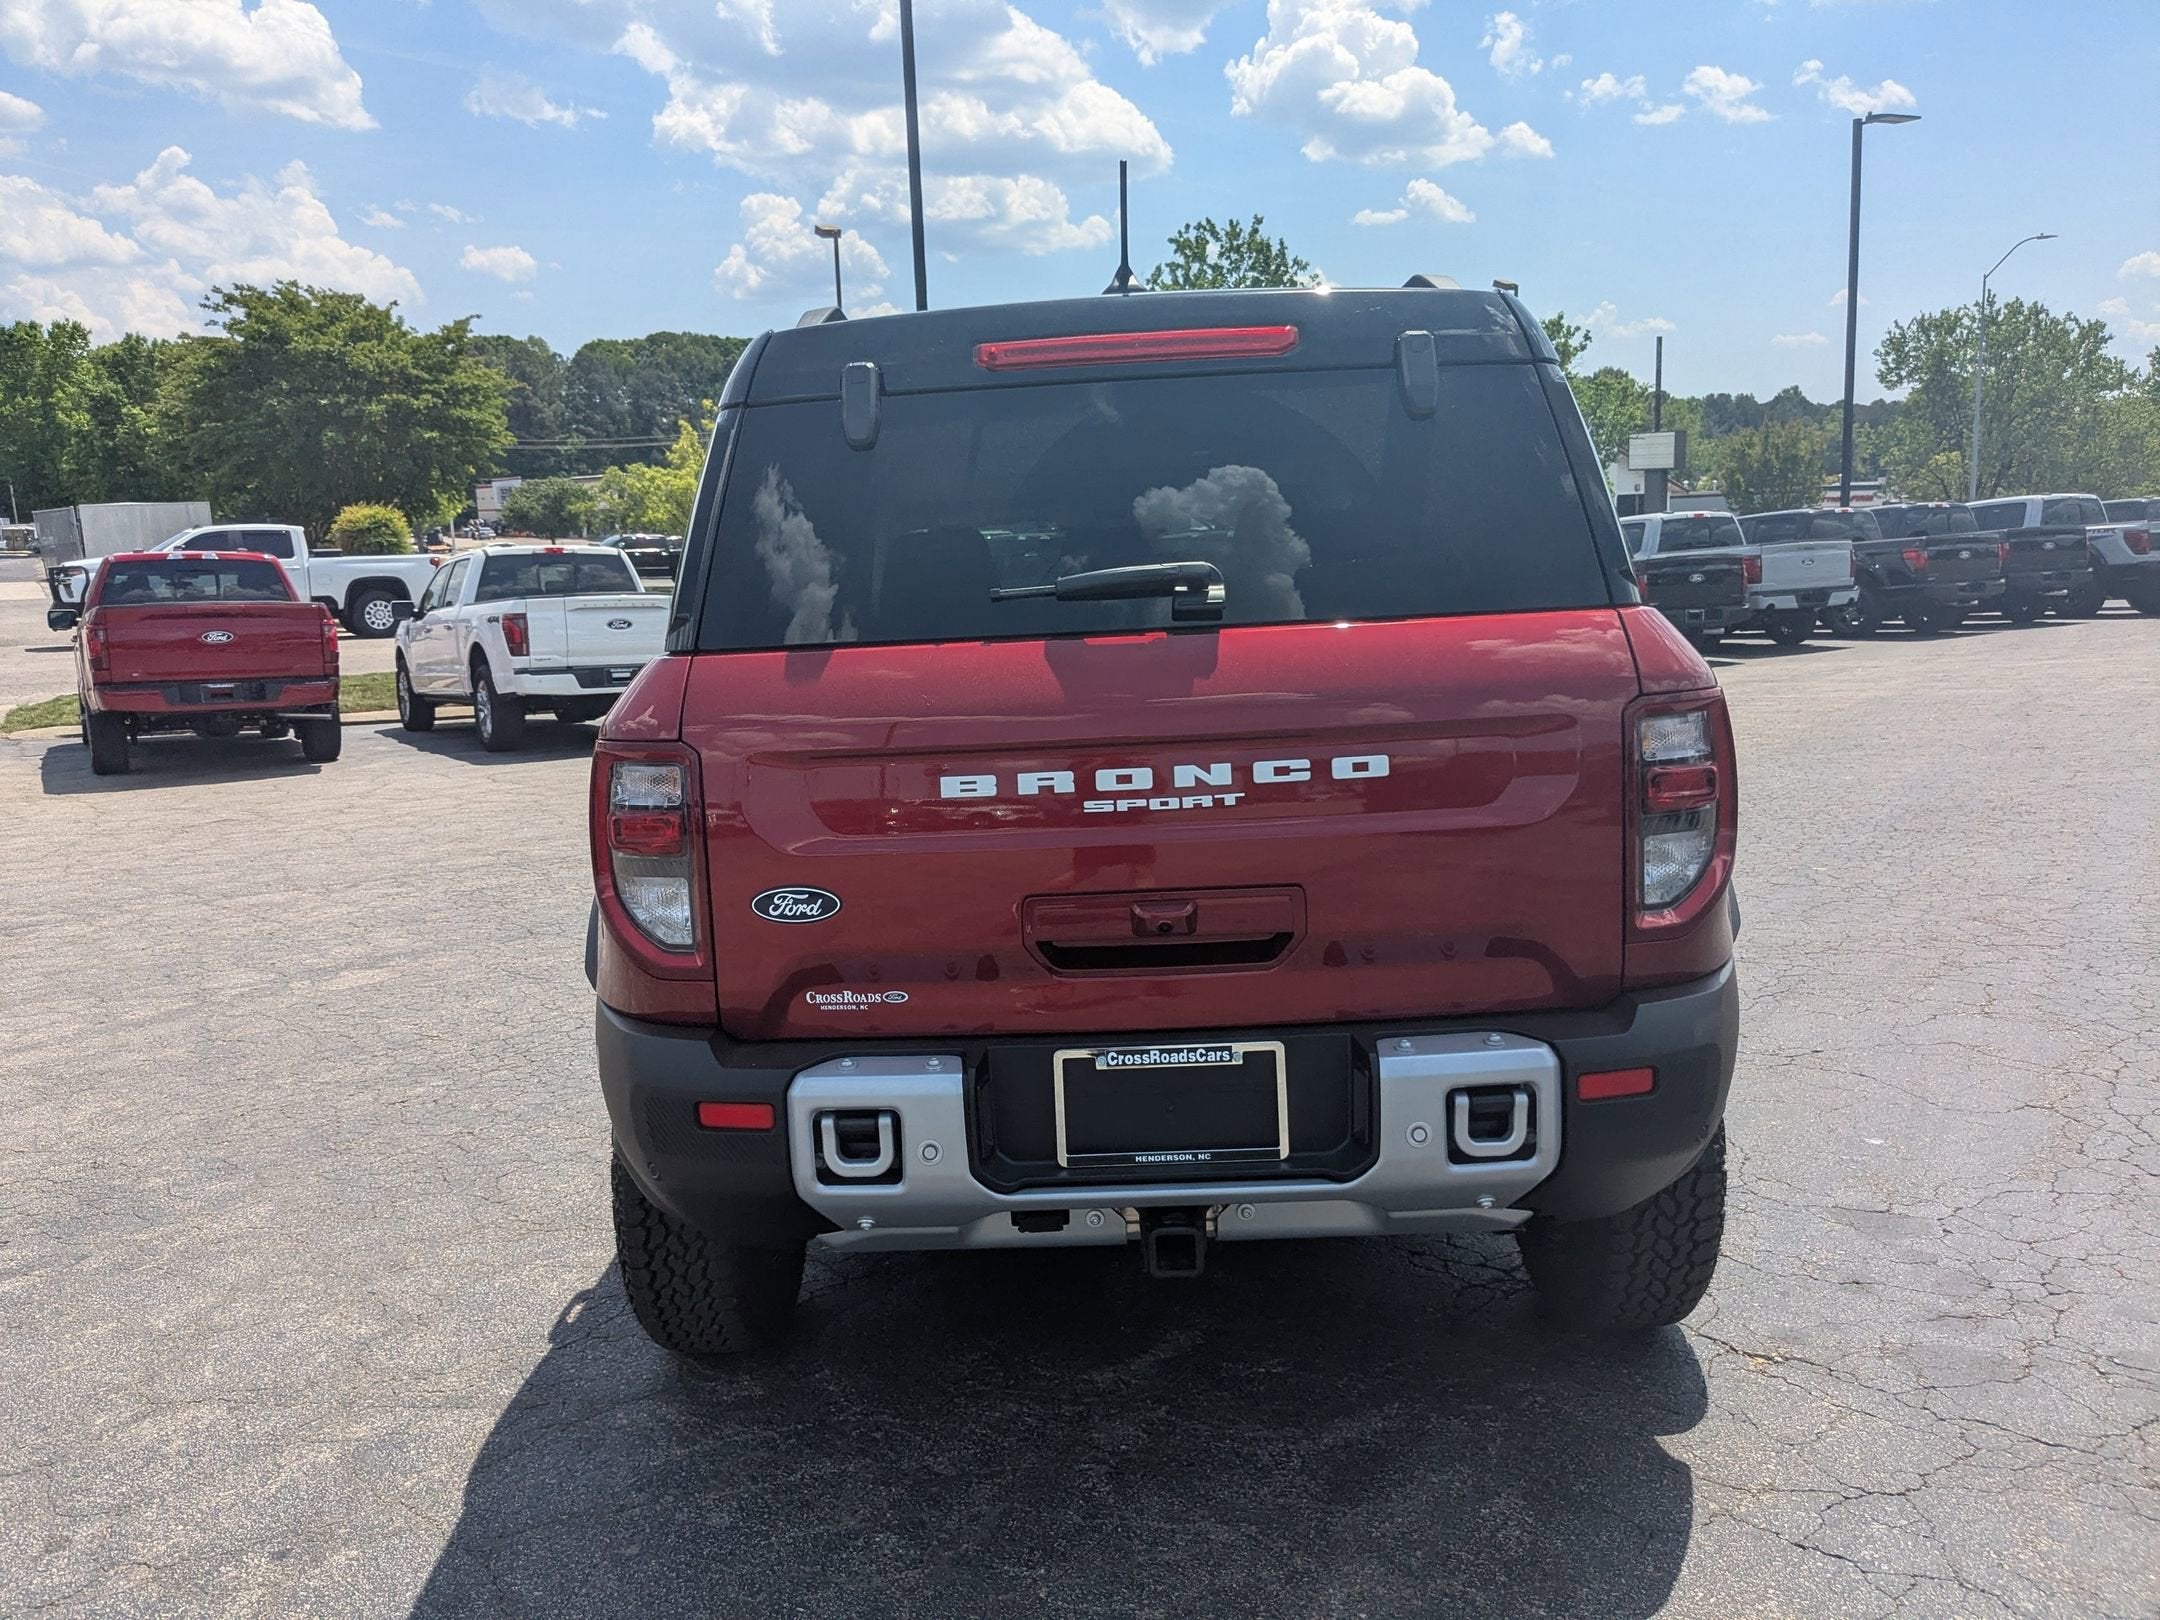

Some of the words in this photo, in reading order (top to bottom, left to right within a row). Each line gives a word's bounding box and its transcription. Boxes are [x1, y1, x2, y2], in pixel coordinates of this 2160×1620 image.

[939, 754, 1390, 799] BRONCO
[1083, 792, 1246, 813] SPORT
[768, 893, 823, 916] Ford
[1107, 1048, 1231, 1066] CrossRoadsCars
[1135, 1153, 1196, 1162] HENDERSON,
